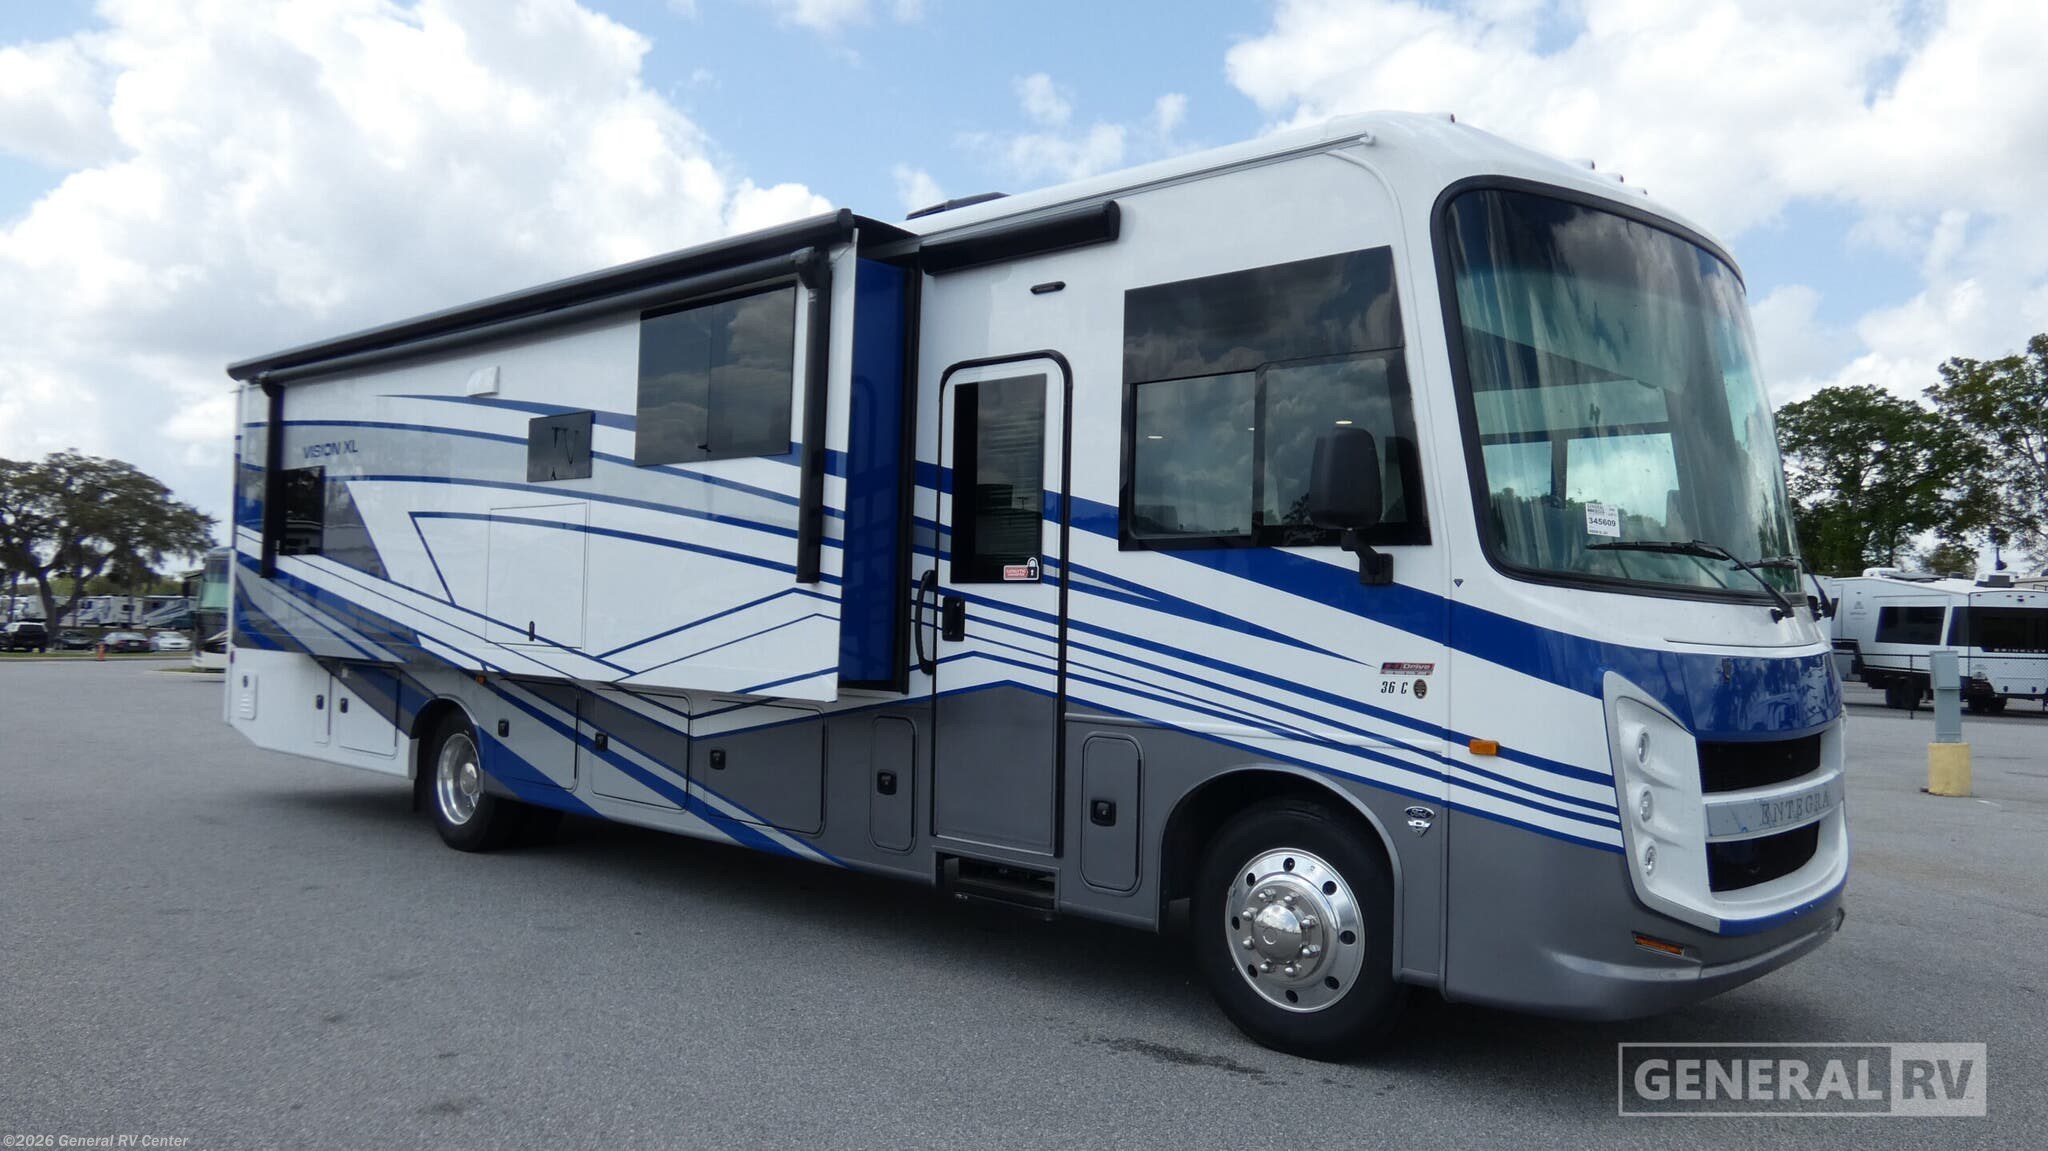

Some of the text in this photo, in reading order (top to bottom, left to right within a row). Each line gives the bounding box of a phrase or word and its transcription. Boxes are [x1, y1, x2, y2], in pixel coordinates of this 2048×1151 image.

[303, 439, 358, 459] VISION XL
[1588, 517, 1617, 527] 345609
[1380, 680, 1396, 694] 36
[1400, 681, 1408, 694] C
[1760, 791, 1830, 826] ENTEGRA
